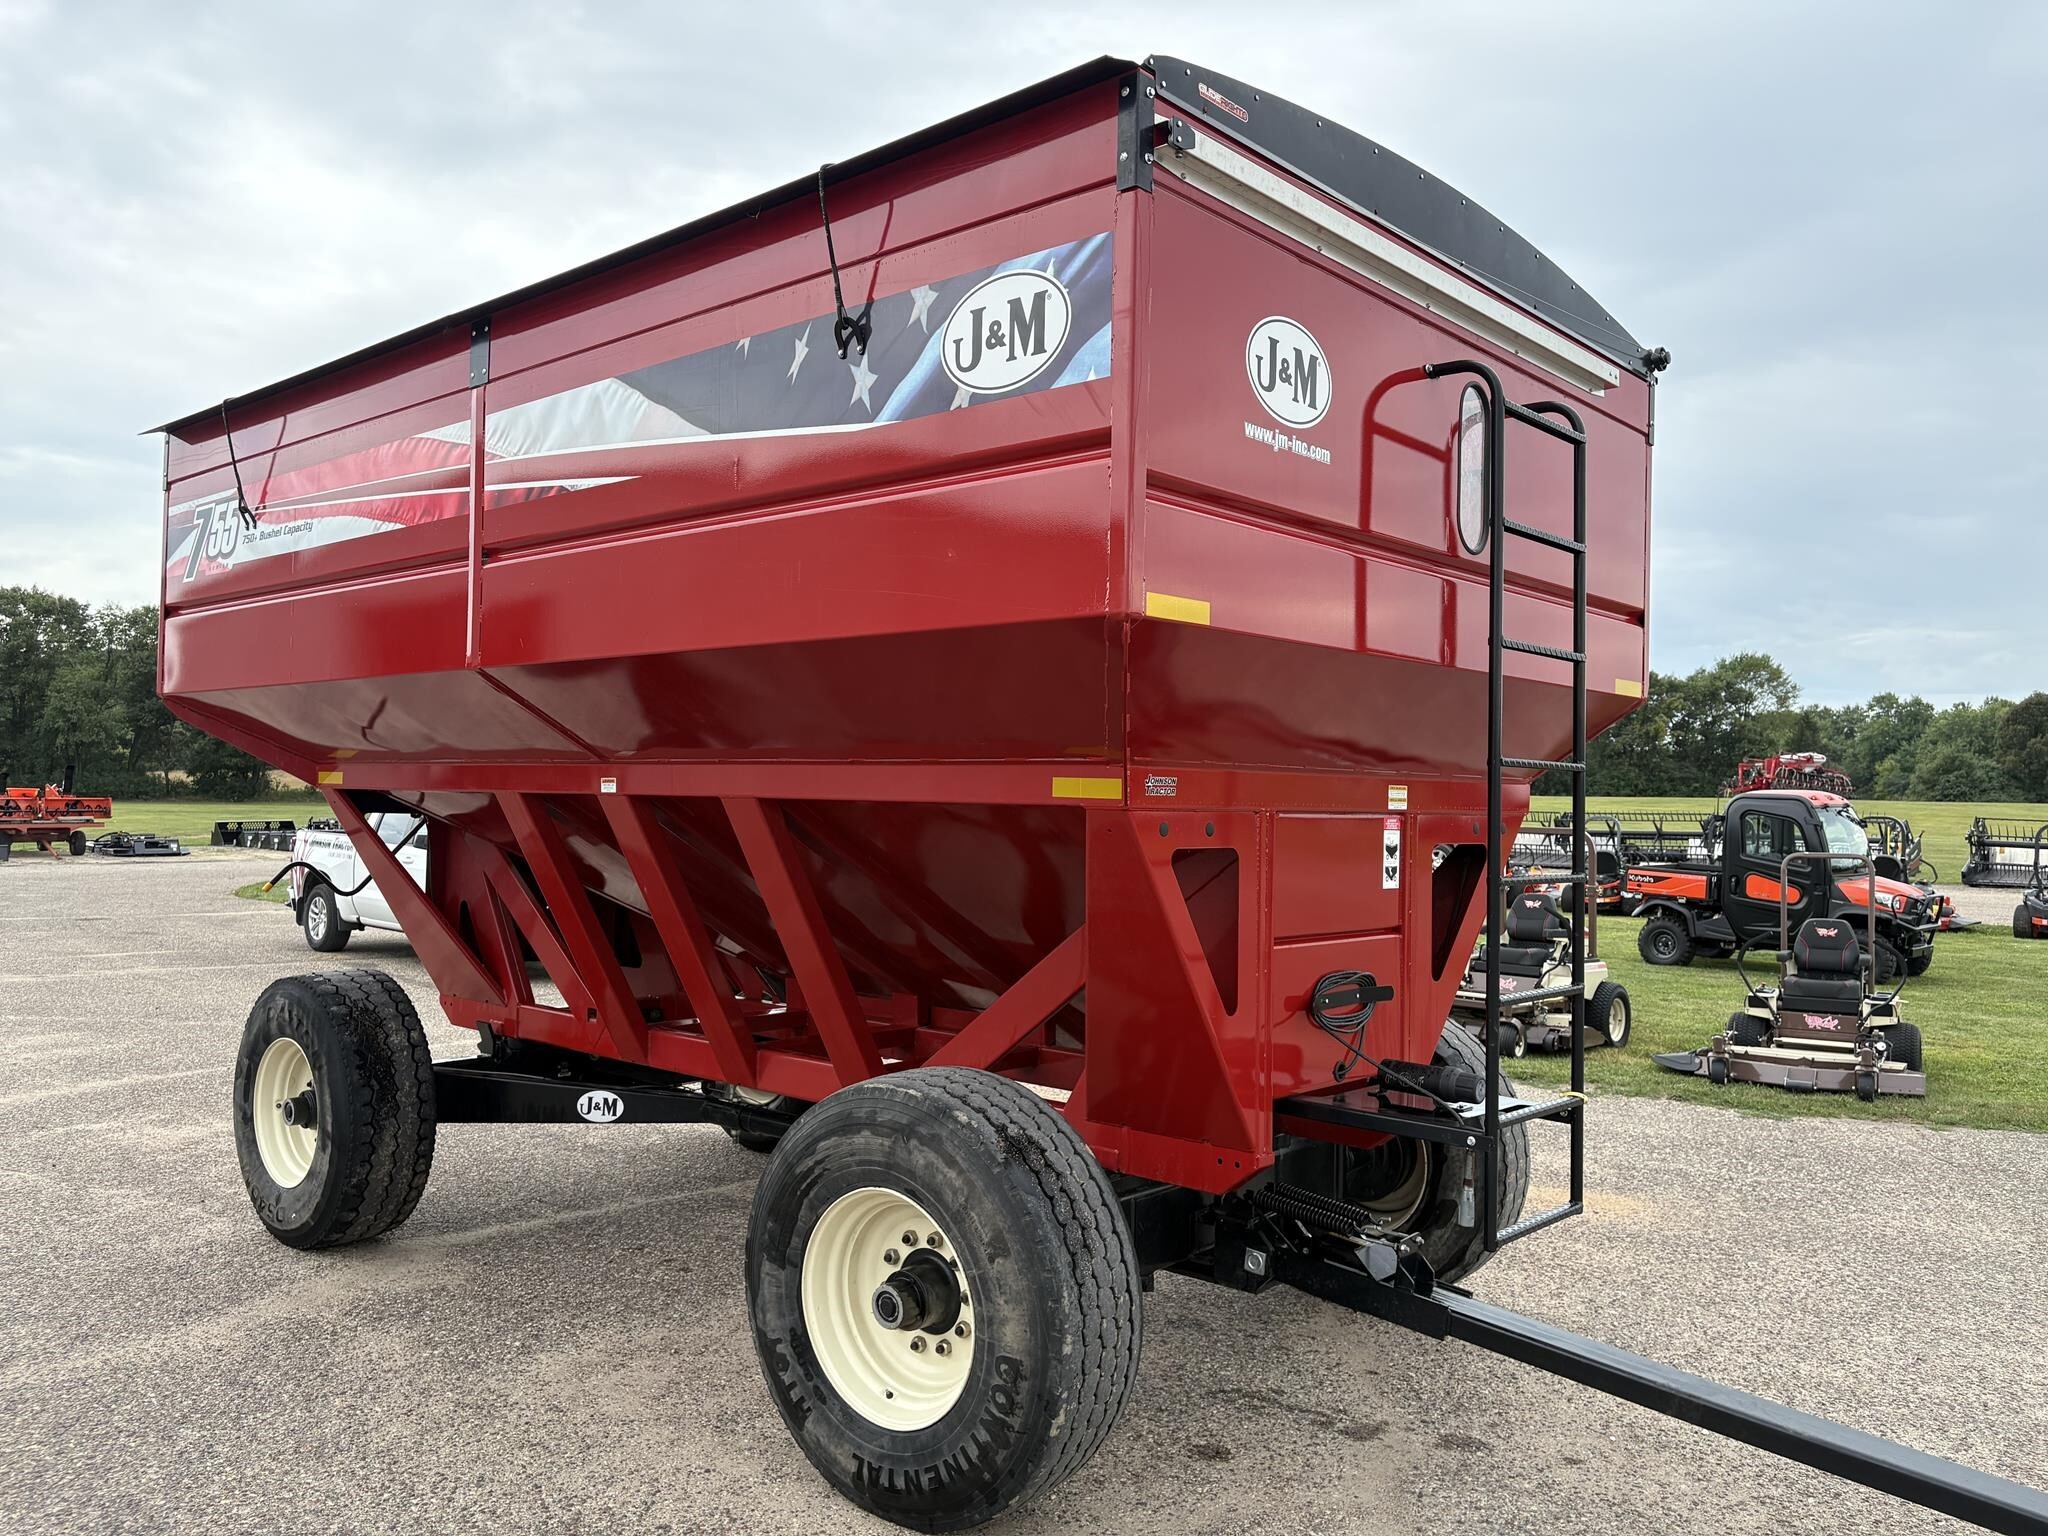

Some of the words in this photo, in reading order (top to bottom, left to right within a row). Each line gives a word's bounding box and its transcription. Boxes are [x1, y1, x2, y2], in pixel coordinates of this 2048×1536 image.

[952, 289, 1048, 373] J&M
[1255, 336, 1319, 410] J&M
[1244, 421, 1331, 464] www.jm-inc.com
[183, 501, 240, 583] 755
[242, 534, 257, 545] 750+
[259, 526, 283, 541] Bushel
[283, 521, 314, 537] Capacity
[1145, 773, 1177, 785] JOHNSON
[1145, 785, 1176, 796] TRACTOR
[1628, 874, 1654, 883] Kubota
[580, 1095, 619, 1117] J&M
[852, 1355, 1027, 1495] CONTINENTAL
